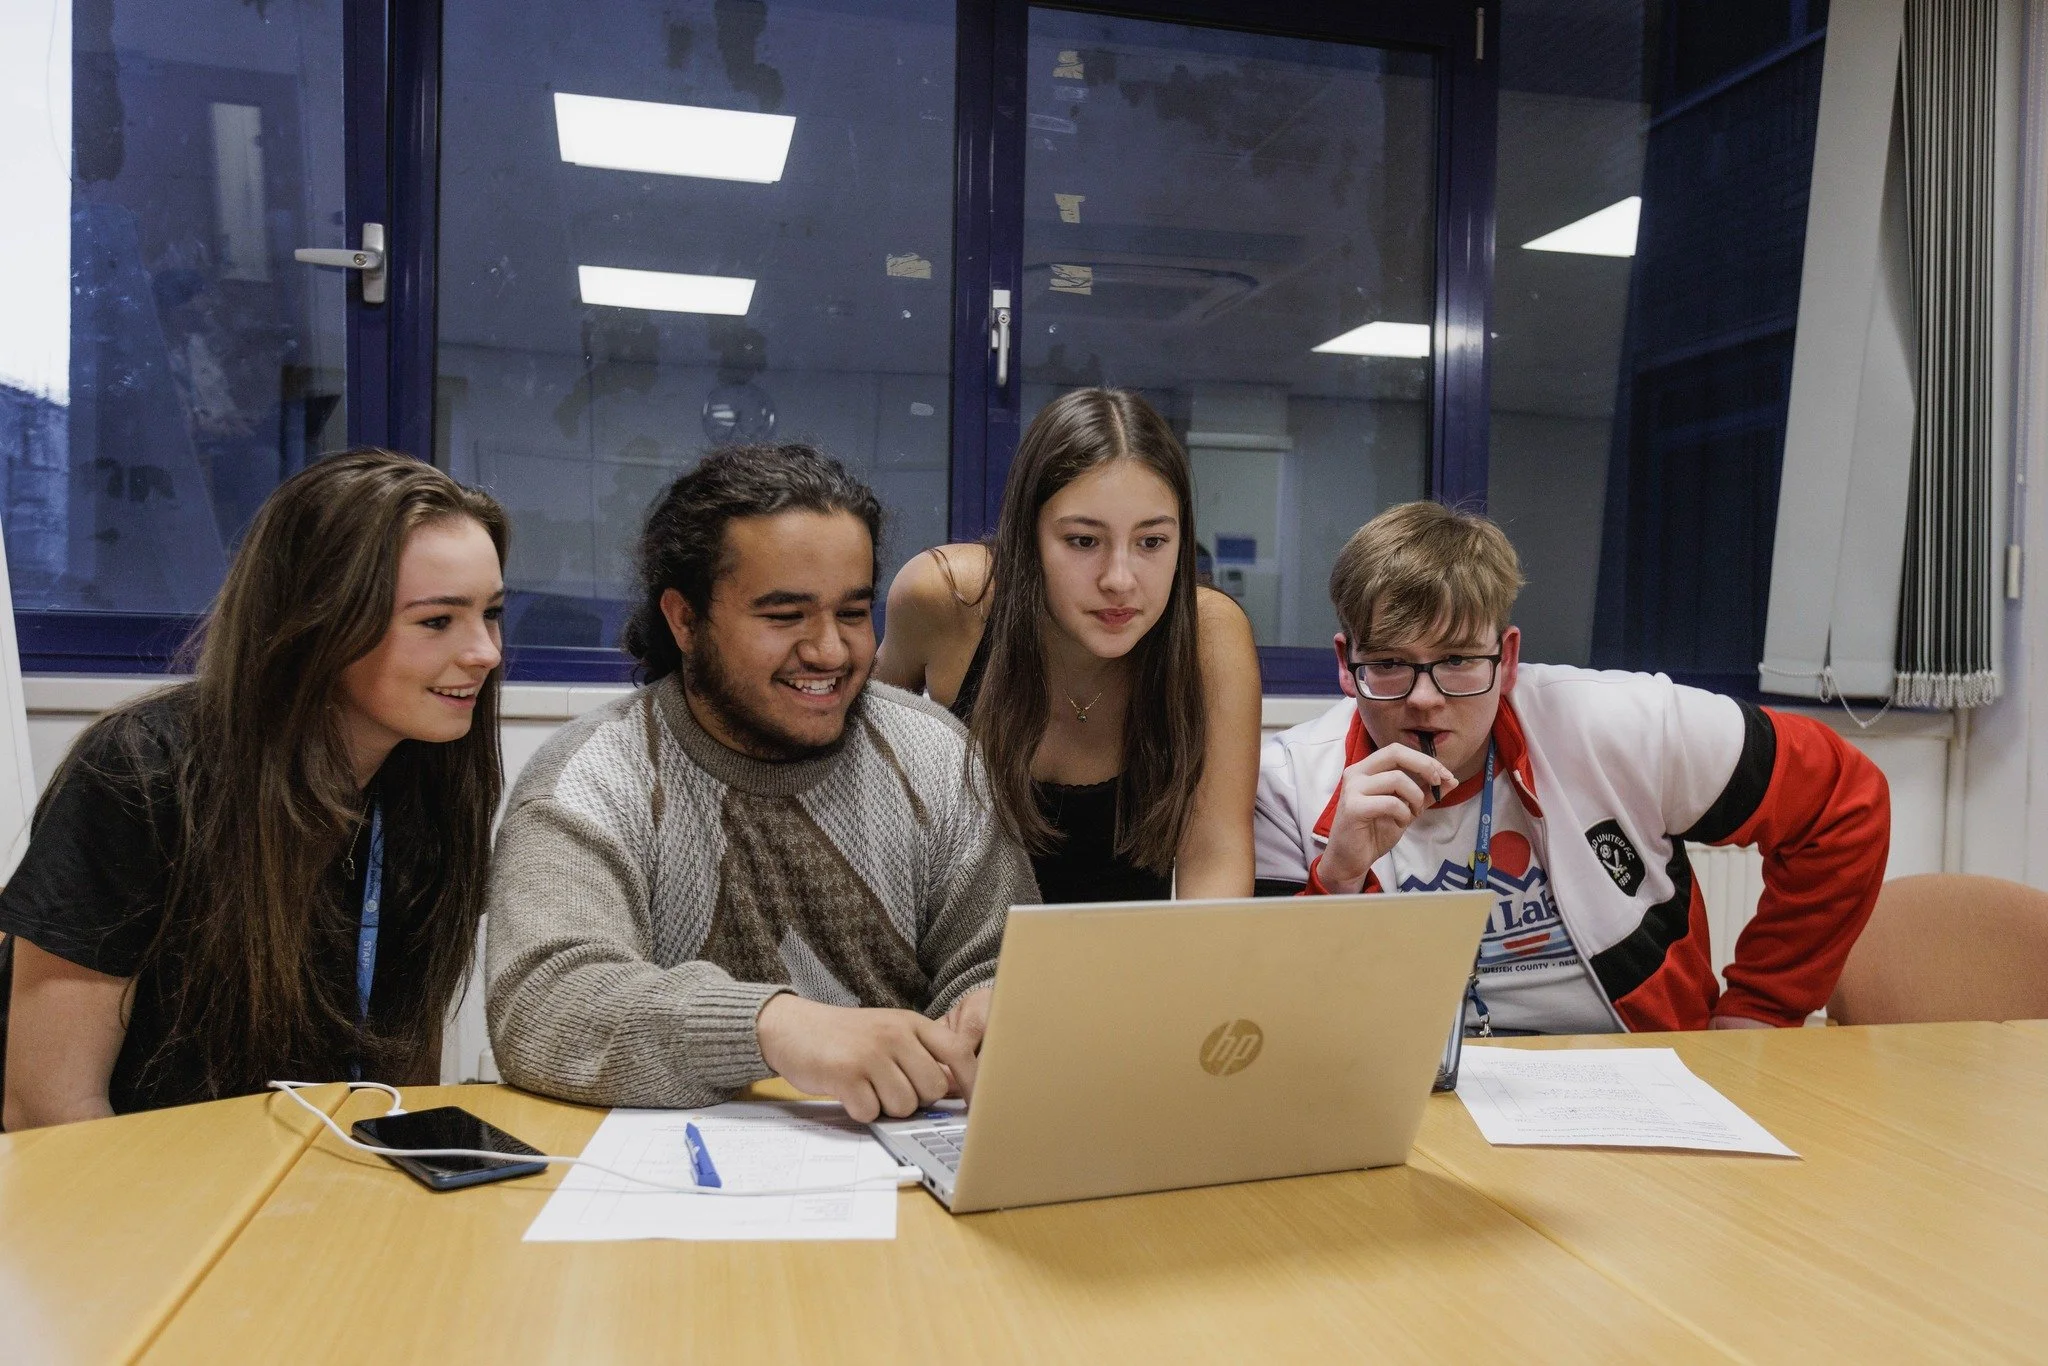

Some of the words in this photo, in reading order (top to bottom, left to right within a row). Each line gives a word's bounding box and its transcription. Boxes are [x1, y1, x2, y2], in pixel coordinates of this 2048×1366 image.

[1597, 833, 1626, 848] UNITED
[363, 940, 372, 969] STAFF
[1515, 962, 1549, 972] COUNTY
[1208, 1020, 1260, 1075] hp
